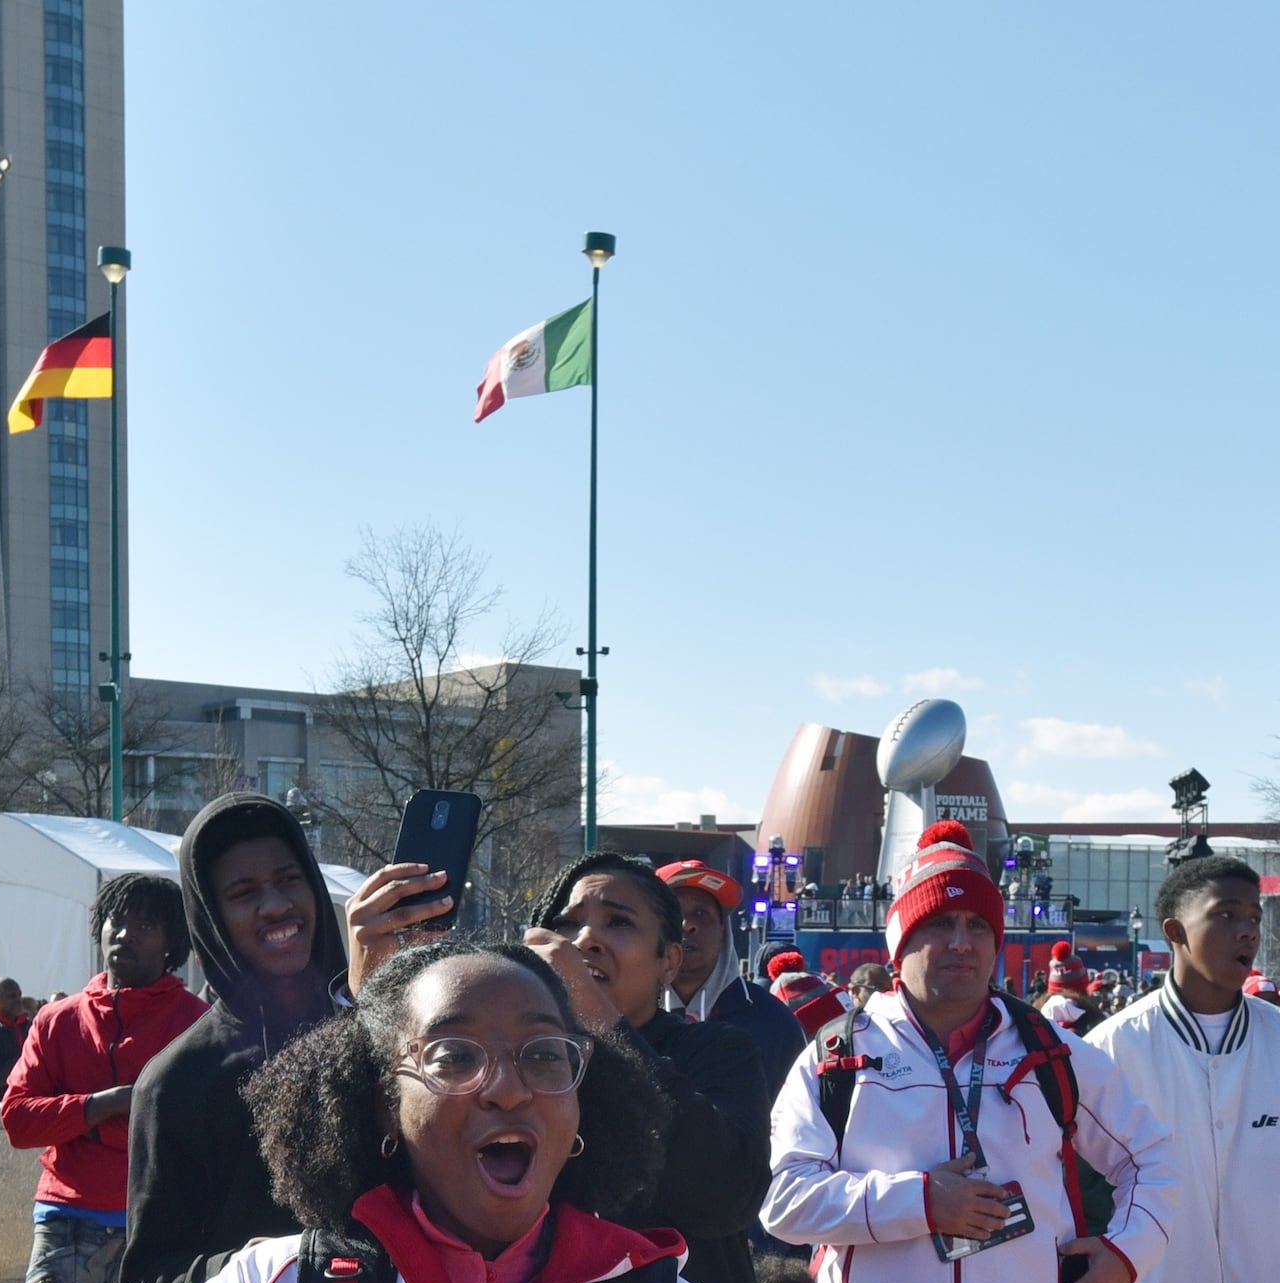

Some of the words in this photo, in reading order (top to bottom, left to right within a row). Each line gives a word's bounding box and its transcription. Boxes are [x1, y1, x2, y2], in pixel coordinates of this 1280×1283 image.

[935, 794, 989, 807] FOOTBALL
[949, 806, 989, 822] FAME
[878, 1065, 913, 1079] TLANTA
